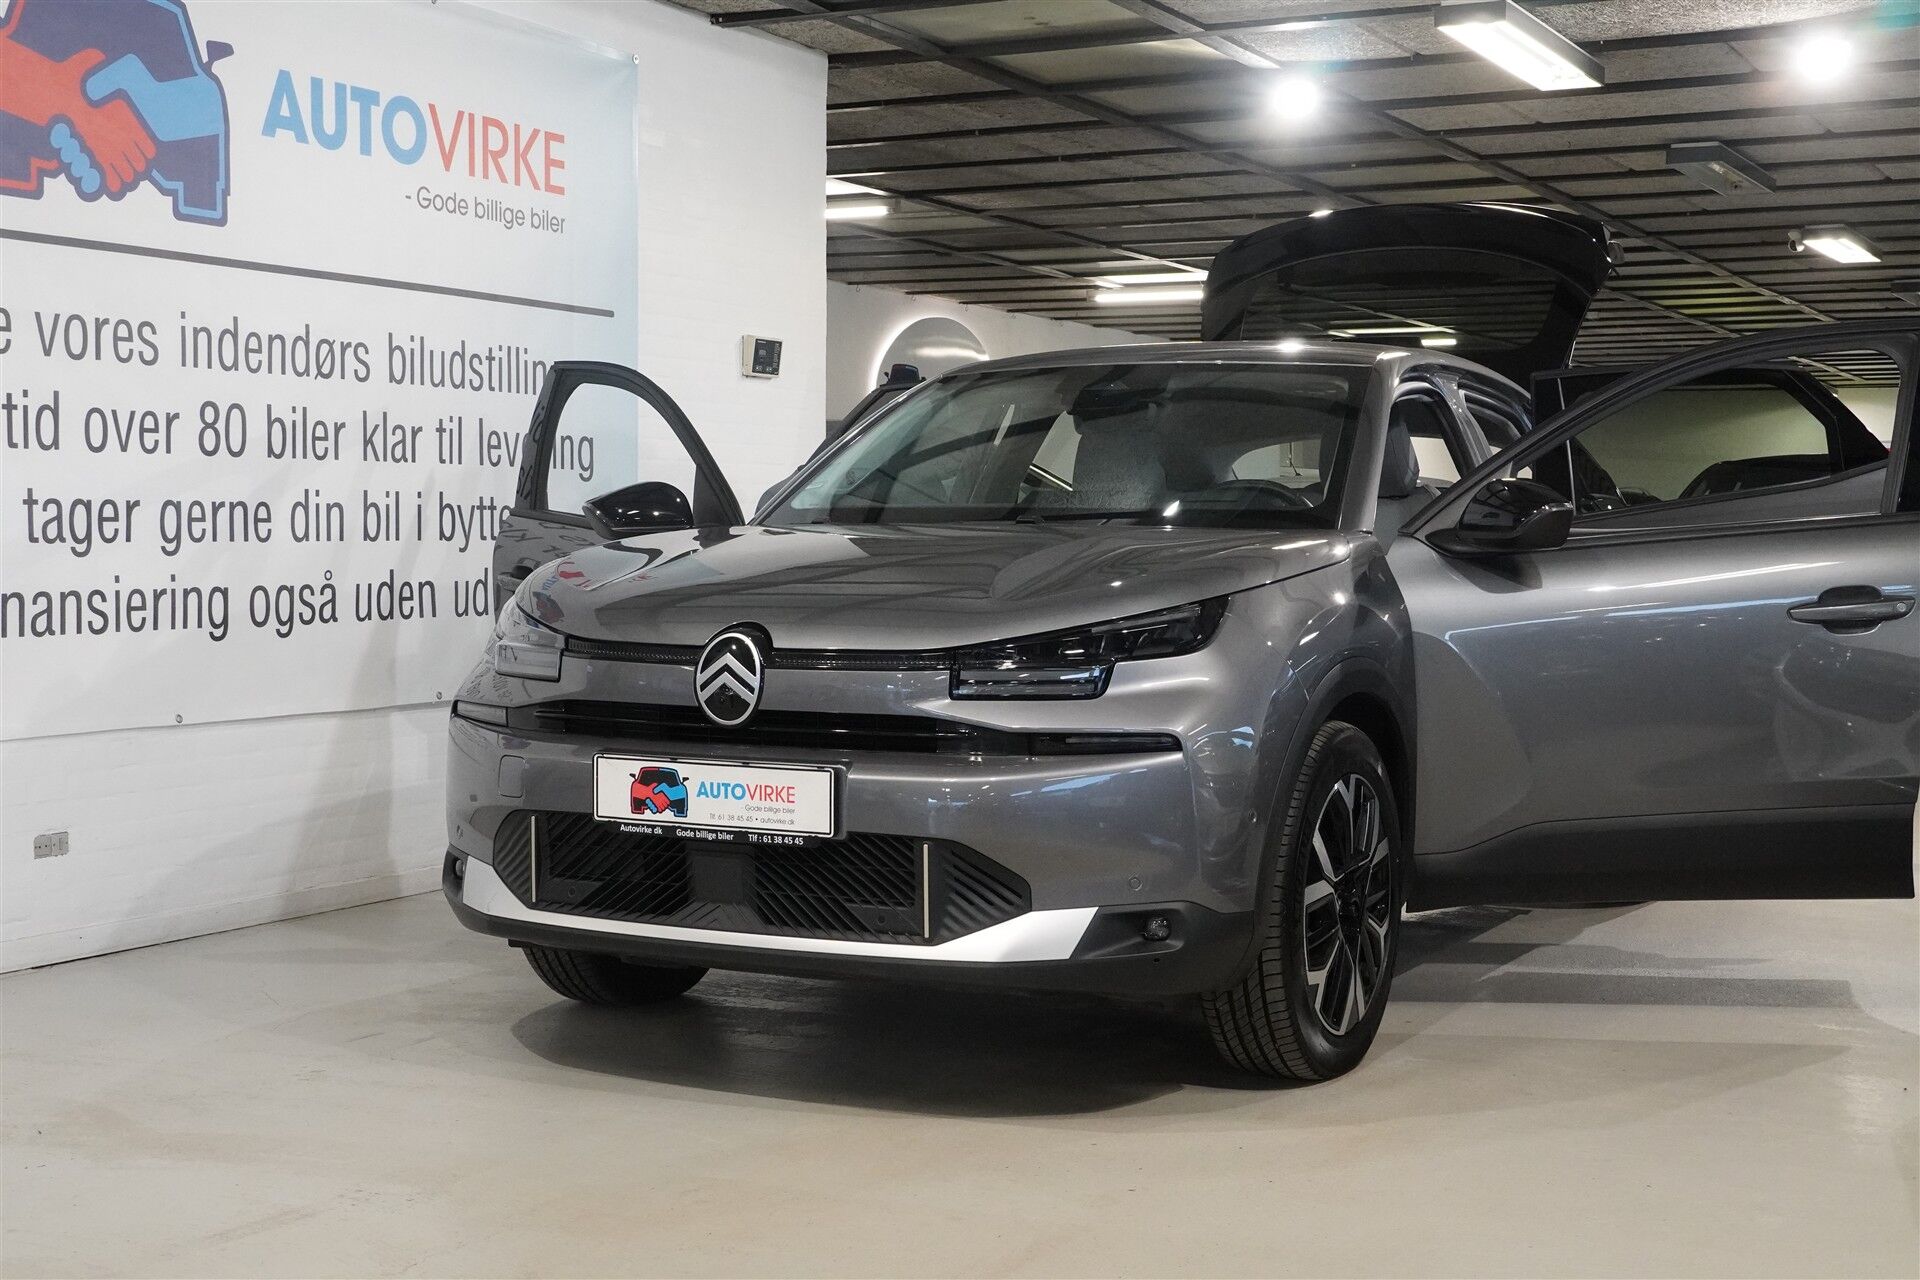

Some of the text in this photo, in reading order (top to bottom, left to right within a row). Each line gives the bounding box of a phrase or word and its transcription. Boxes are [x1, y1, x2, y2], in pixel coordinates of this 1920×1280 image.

[261, 69, 567, 197] AUTOVIRKE
[416, 186, 469, 217] Gode
[474, 197, 527, 230] billige
[530, 208, 566, 234] biler
[34, 311, 159, 367] vores
[180, 310, 371, 383] indendørs
[388, 331, 547, 396] biludstillin
[2, 389, 60, 451] tid
[84, 407, 181, 455] over
[198, 400, 247, 458] 80
[266, 404, 347, 462] biler
[362, 410, 424, 465] klar
[436, 415, 463, 466] til
[22, 487, 141, 559] tager
[159, 499, 272, 556] gerne
[290, 488, 345, 543] din
[362, 489, 400, 543] bil
[417, 490, 422, 542] i
[1, 574, 229, 643] nansiering
[249, 569, 339, 639] også
[355, 569, 437, 623] uden
[696, 780, 796, 804] AUTOVIRKE
[717, 813, 725, 821] 61
[727, 814, 735, 822] 38
[745, 815, 754, 823] 45
[744, 804, 796, 815] Gode billige biler
[676, 828, 695, 838] Gode
[695, 829, 717, 841] billige
[717, 830, 734, 841] biler
[762, 834, 772, 843] 61
[773, 835, 782, 844] 38
[783, 836, 793, 845] 45
[794, 836, 804, 846] 45
